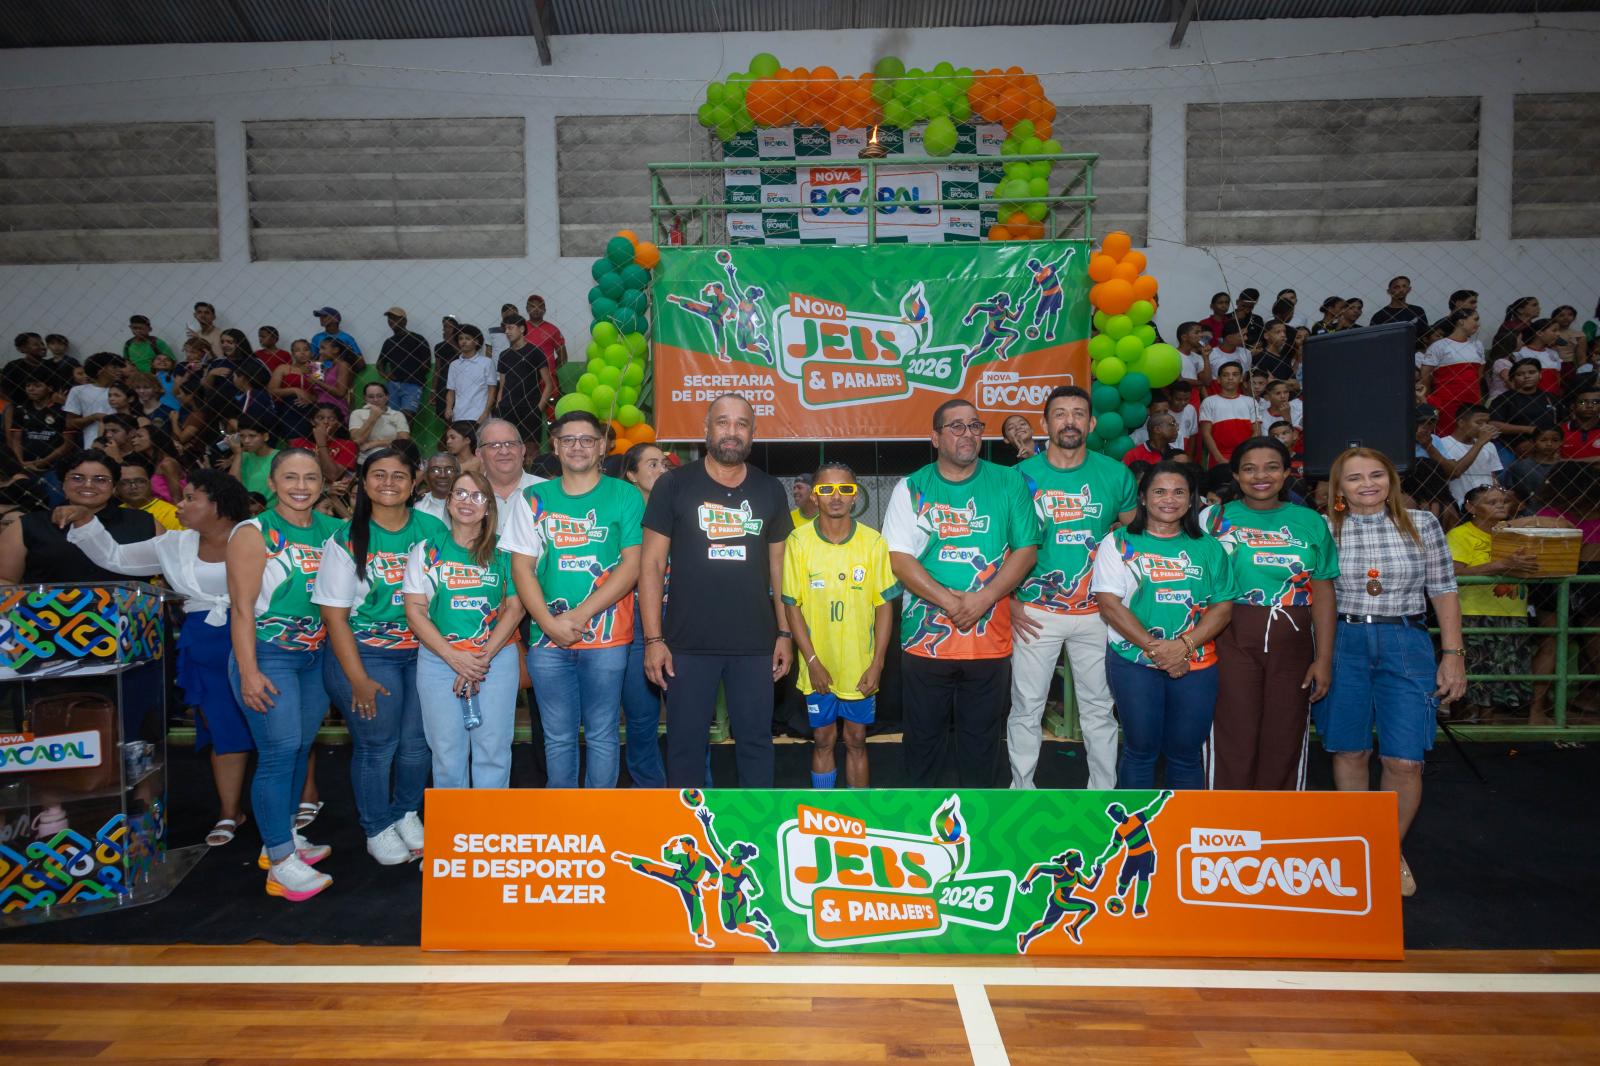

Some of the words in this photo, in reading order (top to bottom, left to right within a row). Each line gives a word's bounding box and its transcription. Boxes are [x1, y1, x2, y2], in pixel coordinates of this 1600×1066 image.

[815, 172, 850, 182] NOVA
[794, 297, 844, 318] NOVO
[787, 319, 901, 361] JEBS
[907, 358, 951, 379] 2026
[684, 374, 774, 387] SECRETARIA
[809, 371, 826, 390] &
[832, 371, 902, 388] PARAJEB'S
[672, 390, 692, 401] DE
[983, 385, 1058, 406] BACABA
[830, 600, 844, 622] 10
[0, 735, 25, 744] OVA
[803, 810, 863, 836] NOVO
[453, 834, 606, 853] SECRETARIA
[1199, 835, 1246, 847] NOVA
[433, 859, 466, 878] DE
[472, 859, 606, 879] DESPORTO
[794, 837, 933, 888] JEBS
[1191, 857, 1357, 896] BACABAL
[503, 884, 518, 903] E
[524, 884, 606, 904] LAZER
[939, 886, 994, 911] 2026
[820, 899, 842, 923] &
[848, 900, 934, 922] PARAJEB'S
